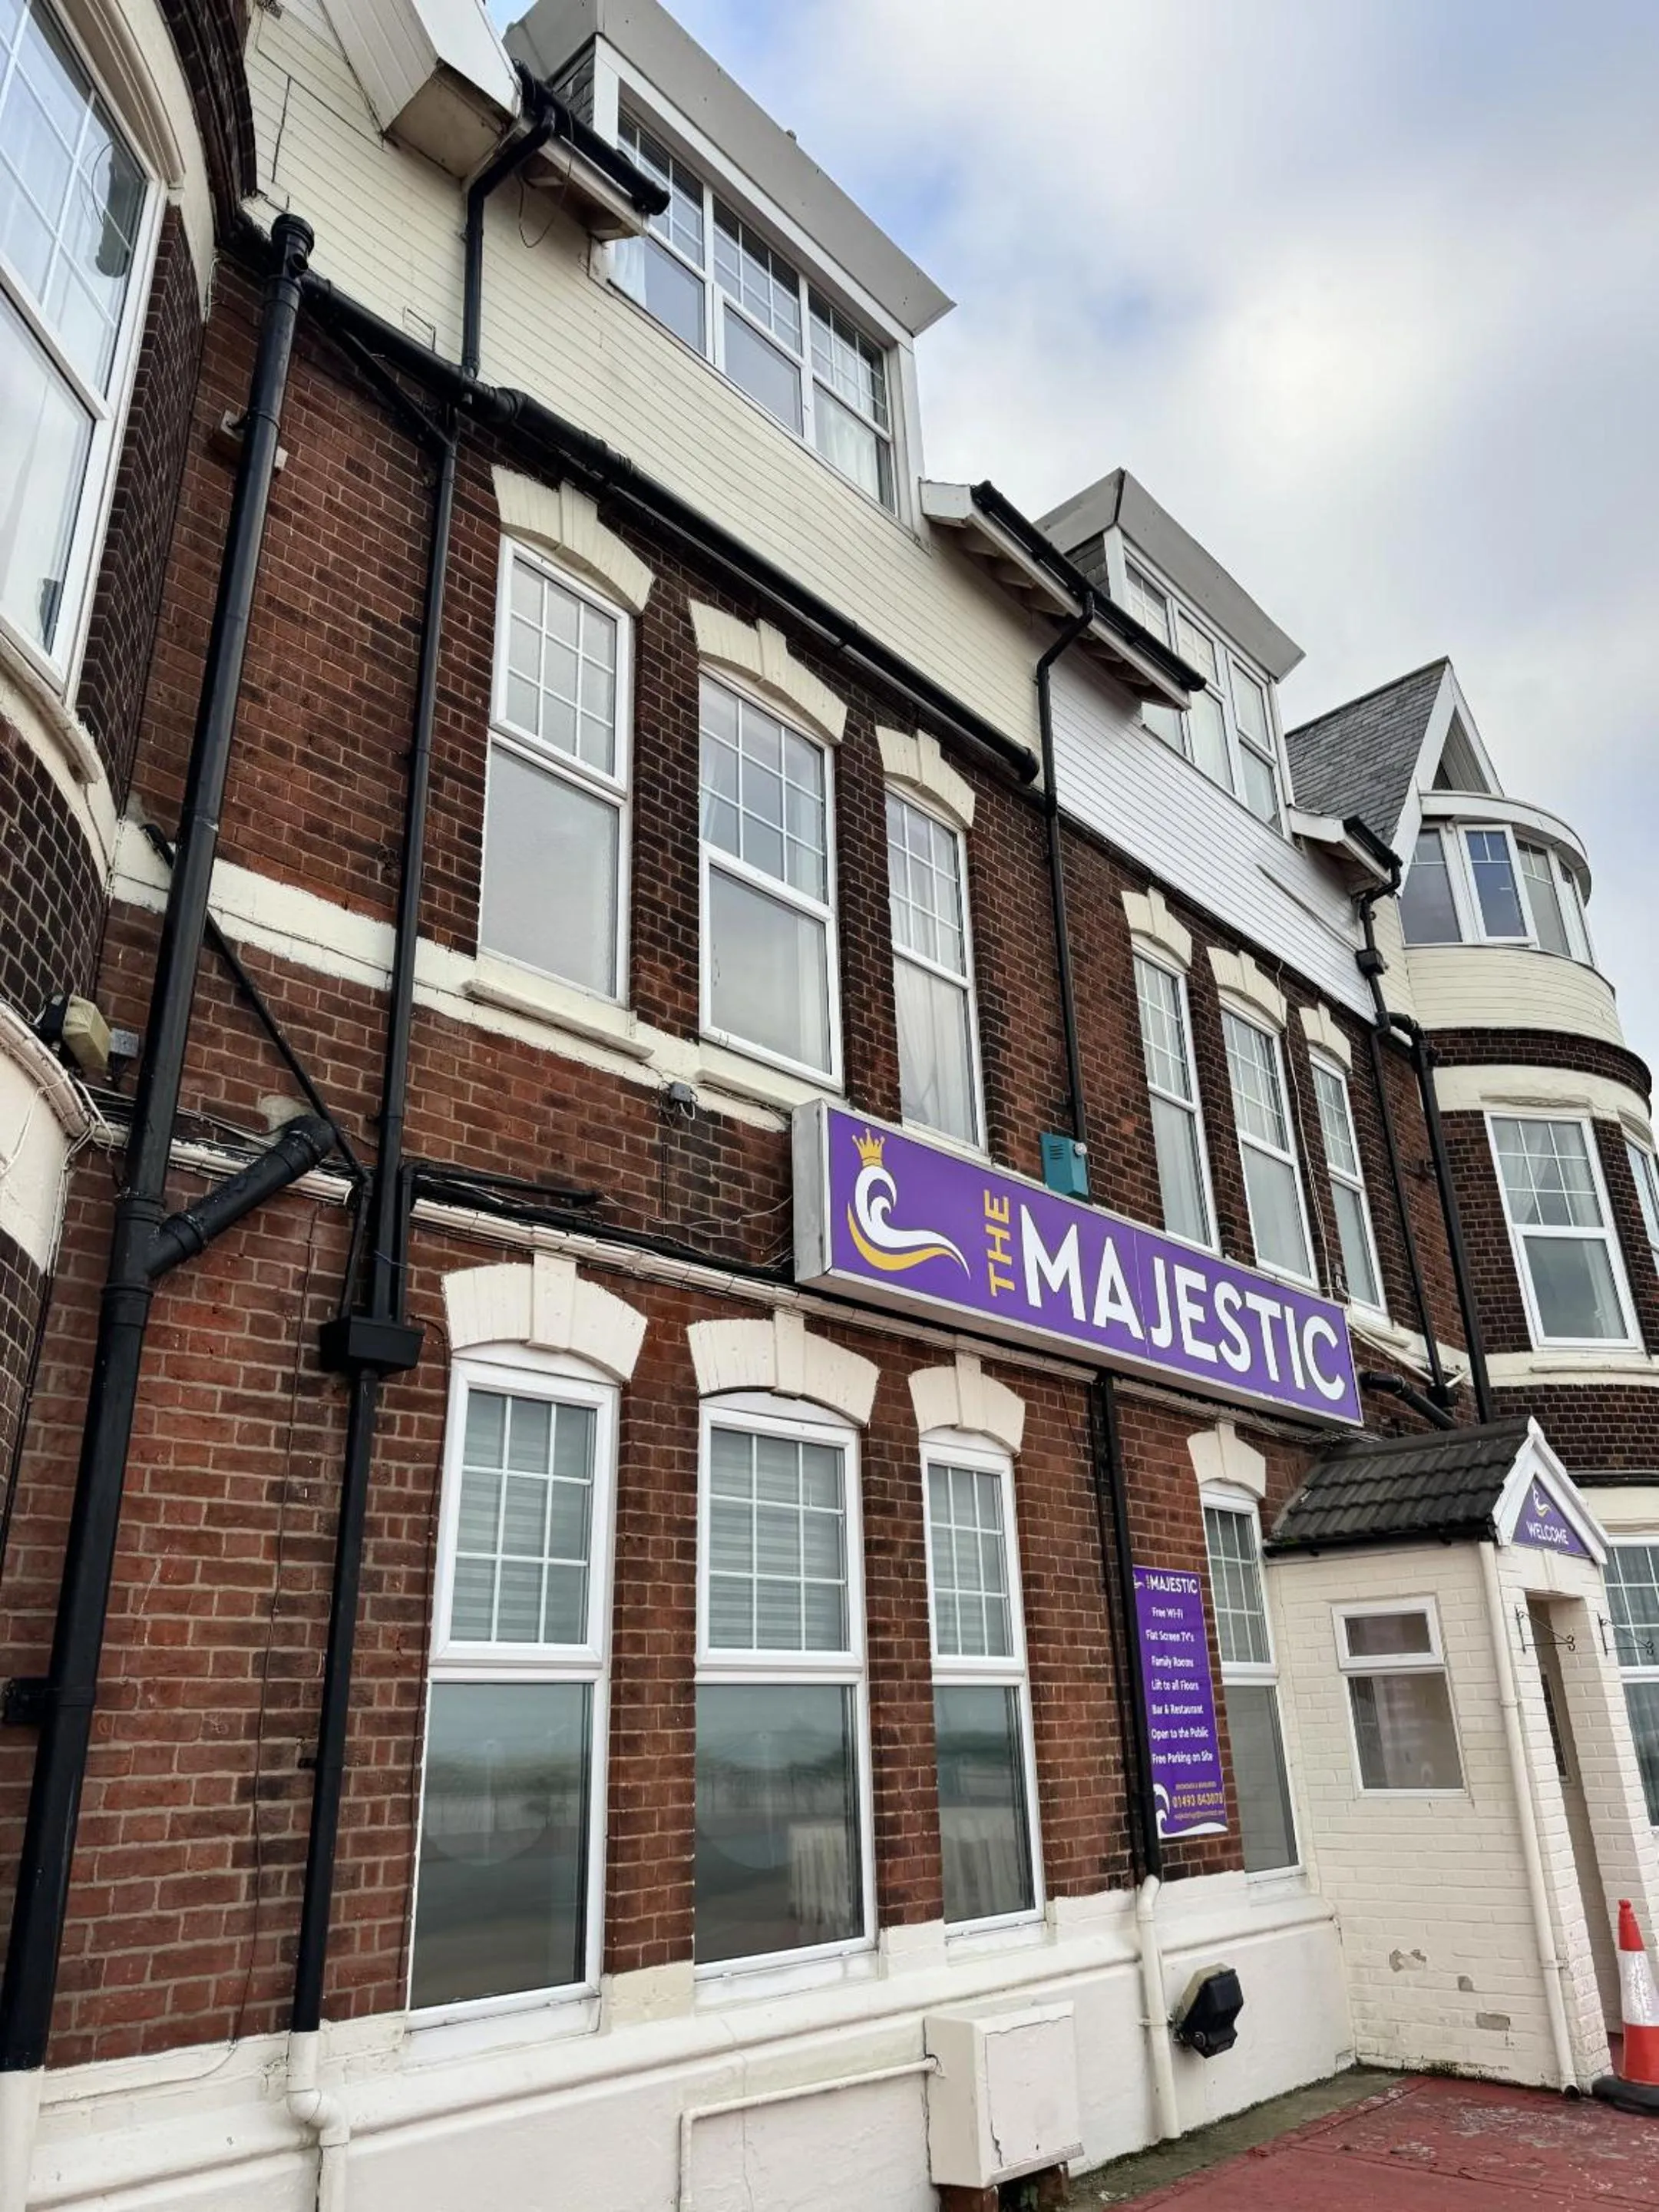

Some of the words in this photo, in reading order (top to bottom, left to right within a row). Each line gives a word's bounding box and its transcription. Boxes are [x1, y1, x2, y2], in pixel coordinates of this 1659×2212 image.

[983, 1188, 1016, 1297] THE
[1020, 1204, 1345, 1400] MAJESTIC
[1525, 1521, 1569, 1545] WELCOME
[1149, 1574, 1198, 1594] MAJESTIC
[1152, 1607, 1165, 1618] Free
[1145, 1629, 1158, 1640] Flat
[1158, 1630, 1180, 1642] Screen
[1151, 1655, 1172, 1668] Family
[1172, 1657, 1194, 1668] Rooms
[1163, 1680, 1171, 1691] to
[1152, 1704, 1162, 1714] Bar
[1164, 1704, 1169, 1714] &
[1170, 1704, 1204, 1714] Restaurant
[1151, 1728, 1168, 1741] Open
[1170, 1728, 1178, 1738] to
[1178, 1727, 1189, 1738] the
[1189, 1726, 1209, 1738] Public
[1152, 1754, 1166, 1764] Free
[1167, 1751, 1191, 1765] Parking
[1192, 1753, 1201, 1762] on
[1201, 1750, 1213, 1761] Site
